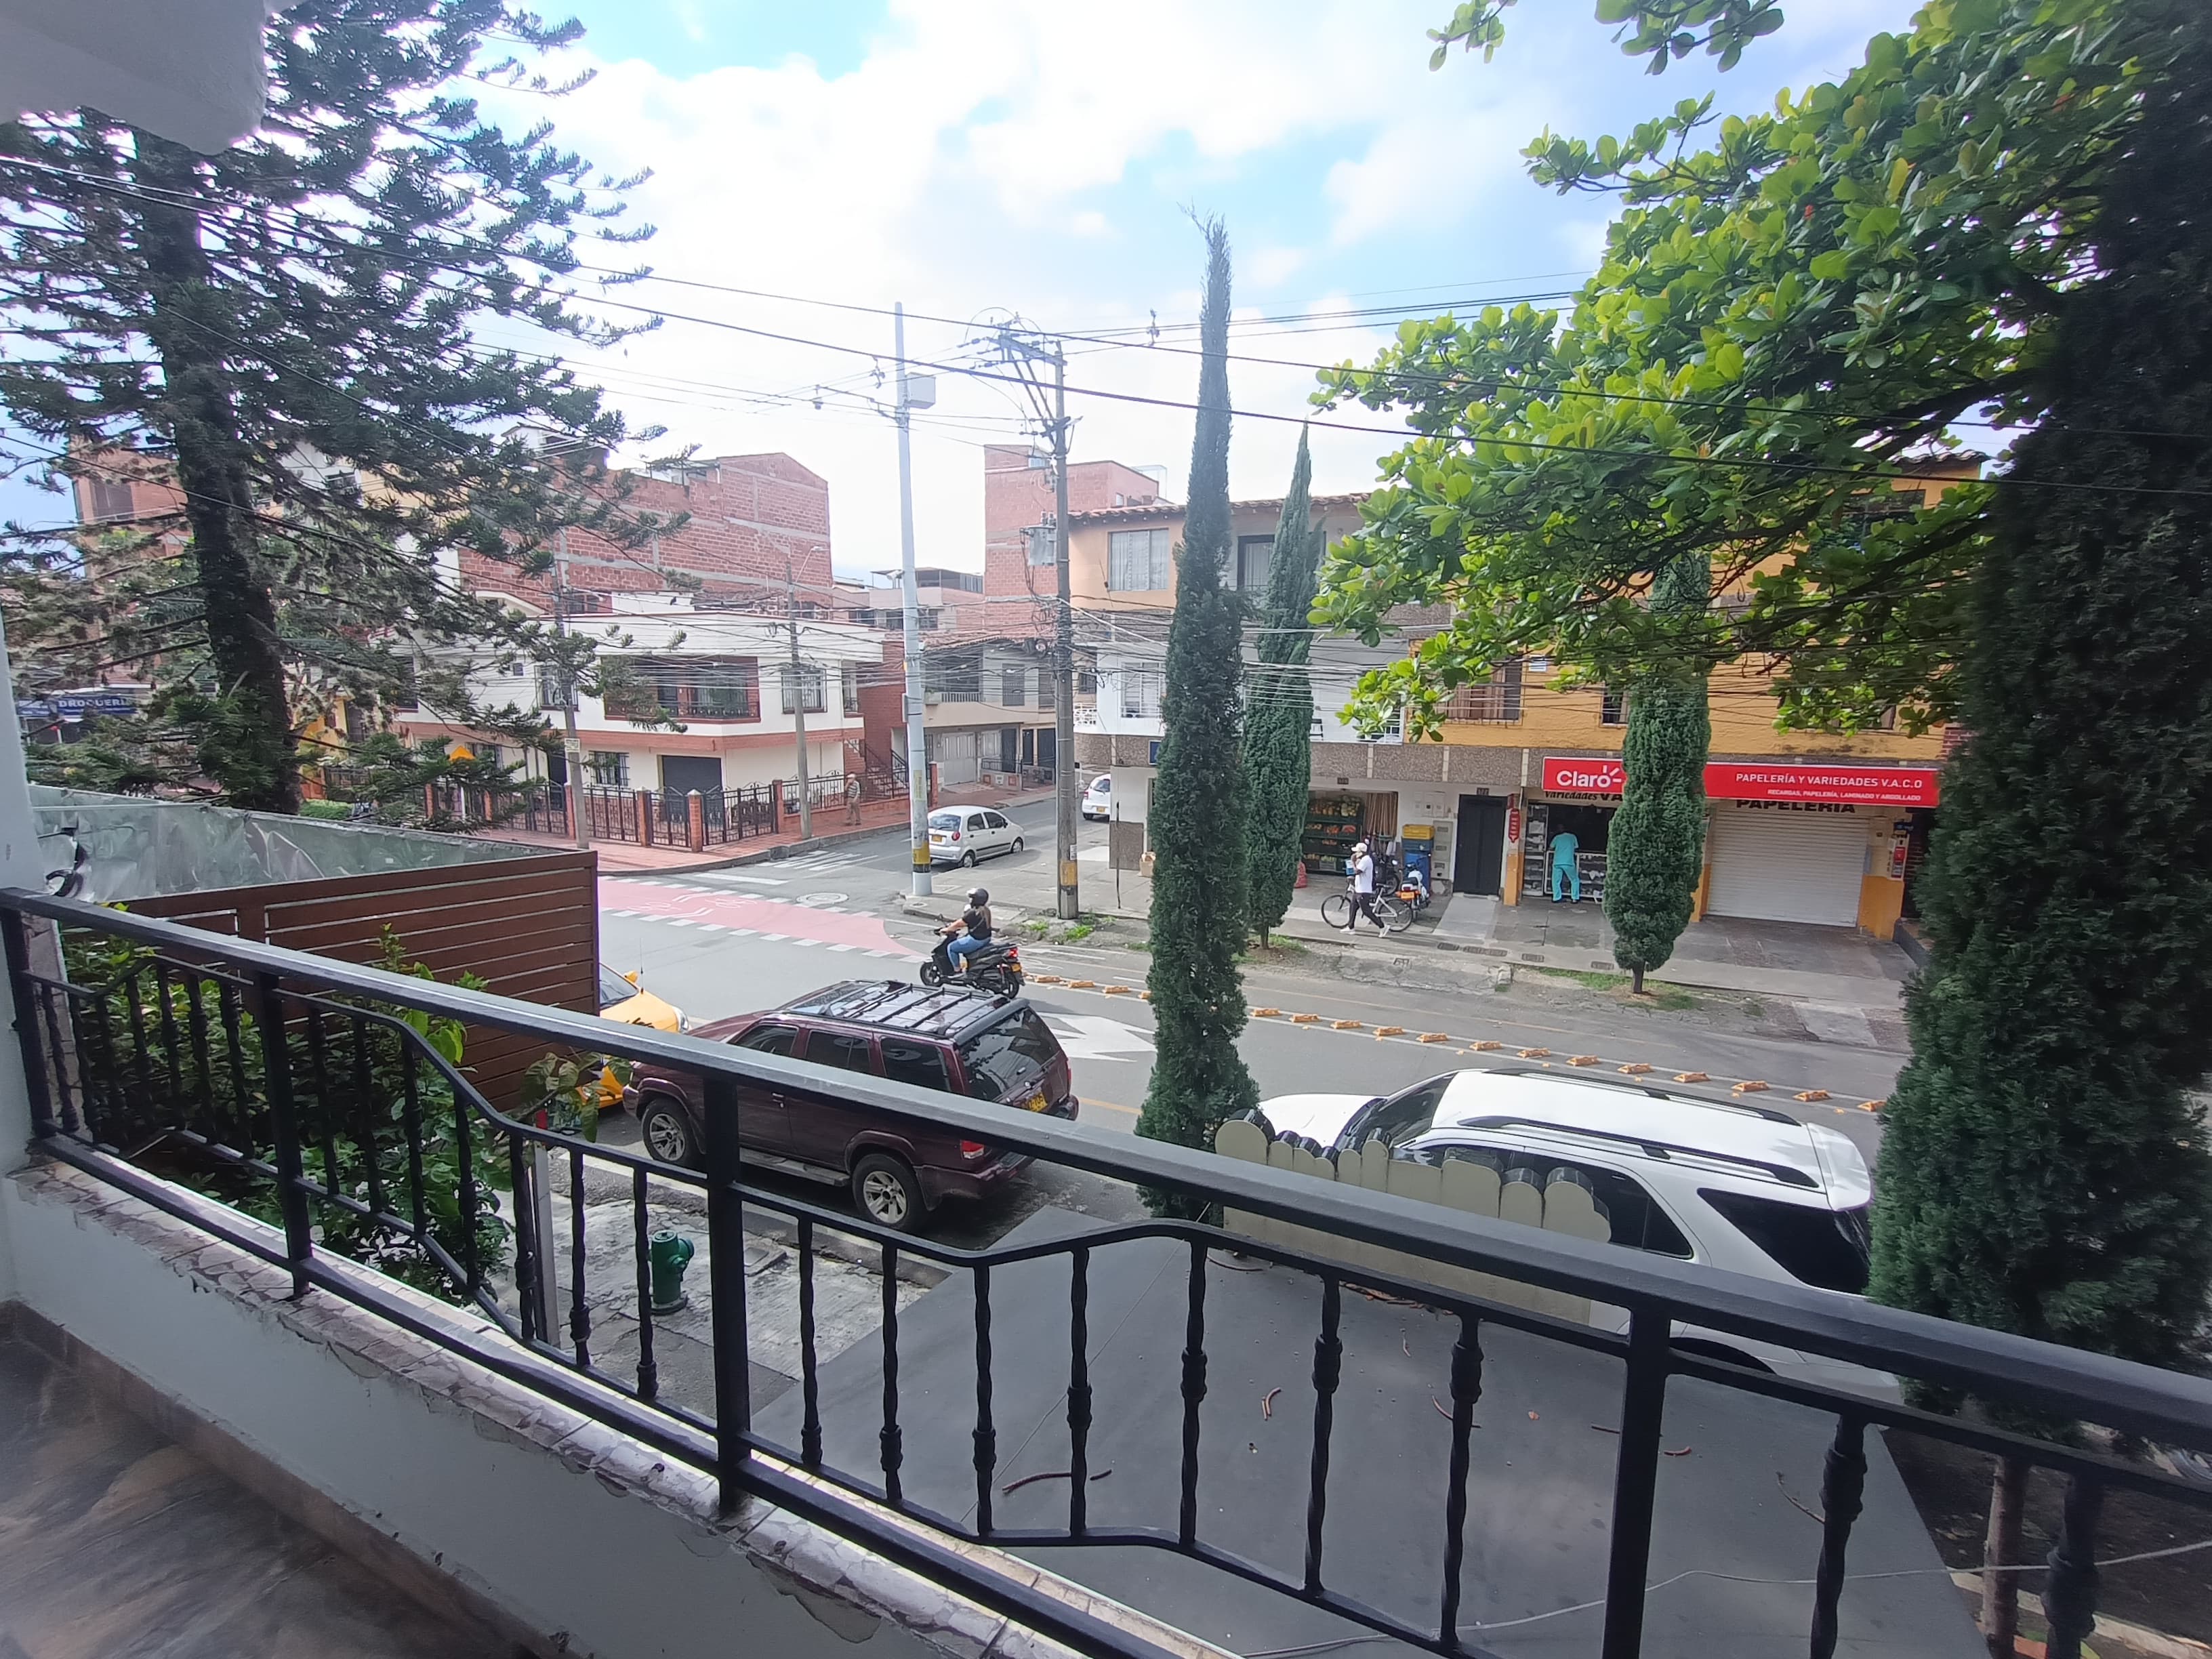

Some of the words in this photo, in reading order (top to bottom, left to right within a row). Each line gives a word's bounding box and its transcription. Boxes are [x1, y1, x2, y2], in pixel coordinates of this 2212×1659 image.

[1557, 770, 1611, 788] Claro
[1736, 773, 1795, 783] PAPELERÍA
[1798, 775, 1805, 784] Y
[1807, 776, 1879, 787] VARIEDADES
[1881, 779, 1923, 789] V.A.C.O
[1736, 800, 1856, 814] PAPELERIA
